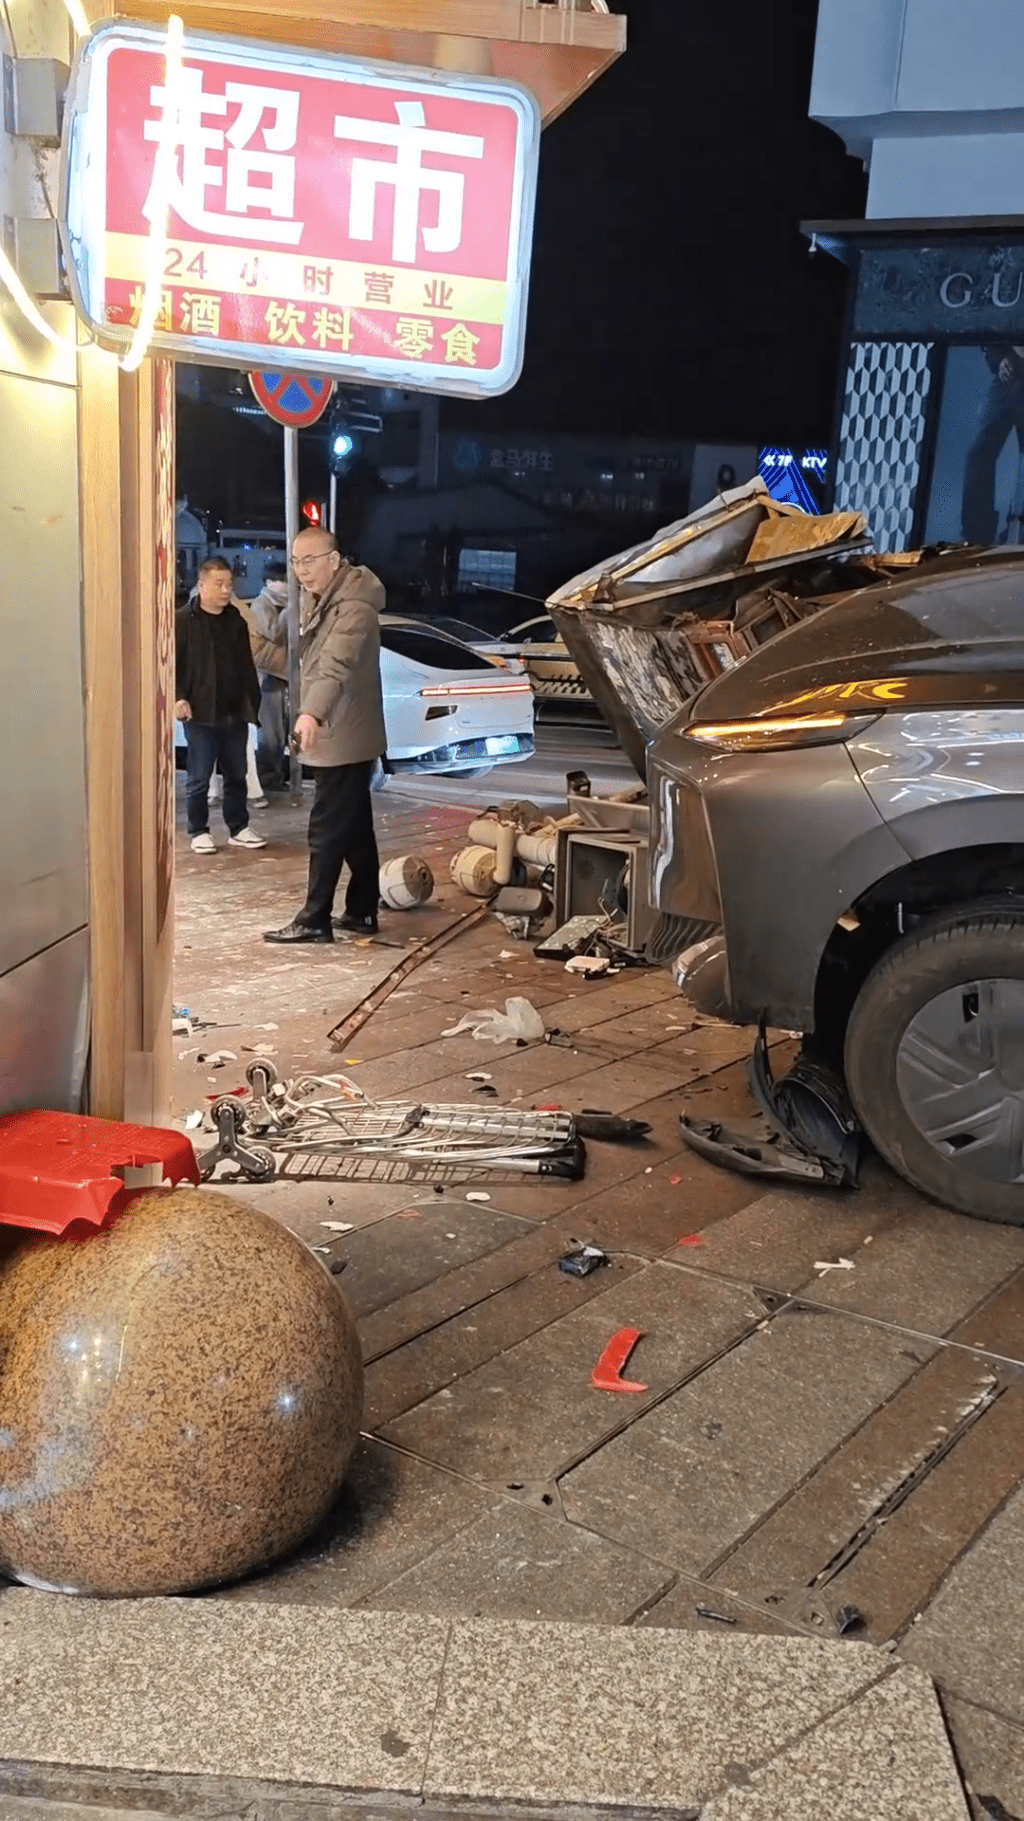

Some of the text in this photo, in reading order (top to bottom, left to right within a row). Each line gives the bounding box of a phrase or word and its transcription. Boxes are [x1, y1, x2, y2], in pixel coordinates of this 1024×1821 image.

[141, 66, 484, 264] 超市
[265, 300, 354, 352] 饮料
[394, 316, 481, 367] 零食
[802, 456, 828, 469] KTV
